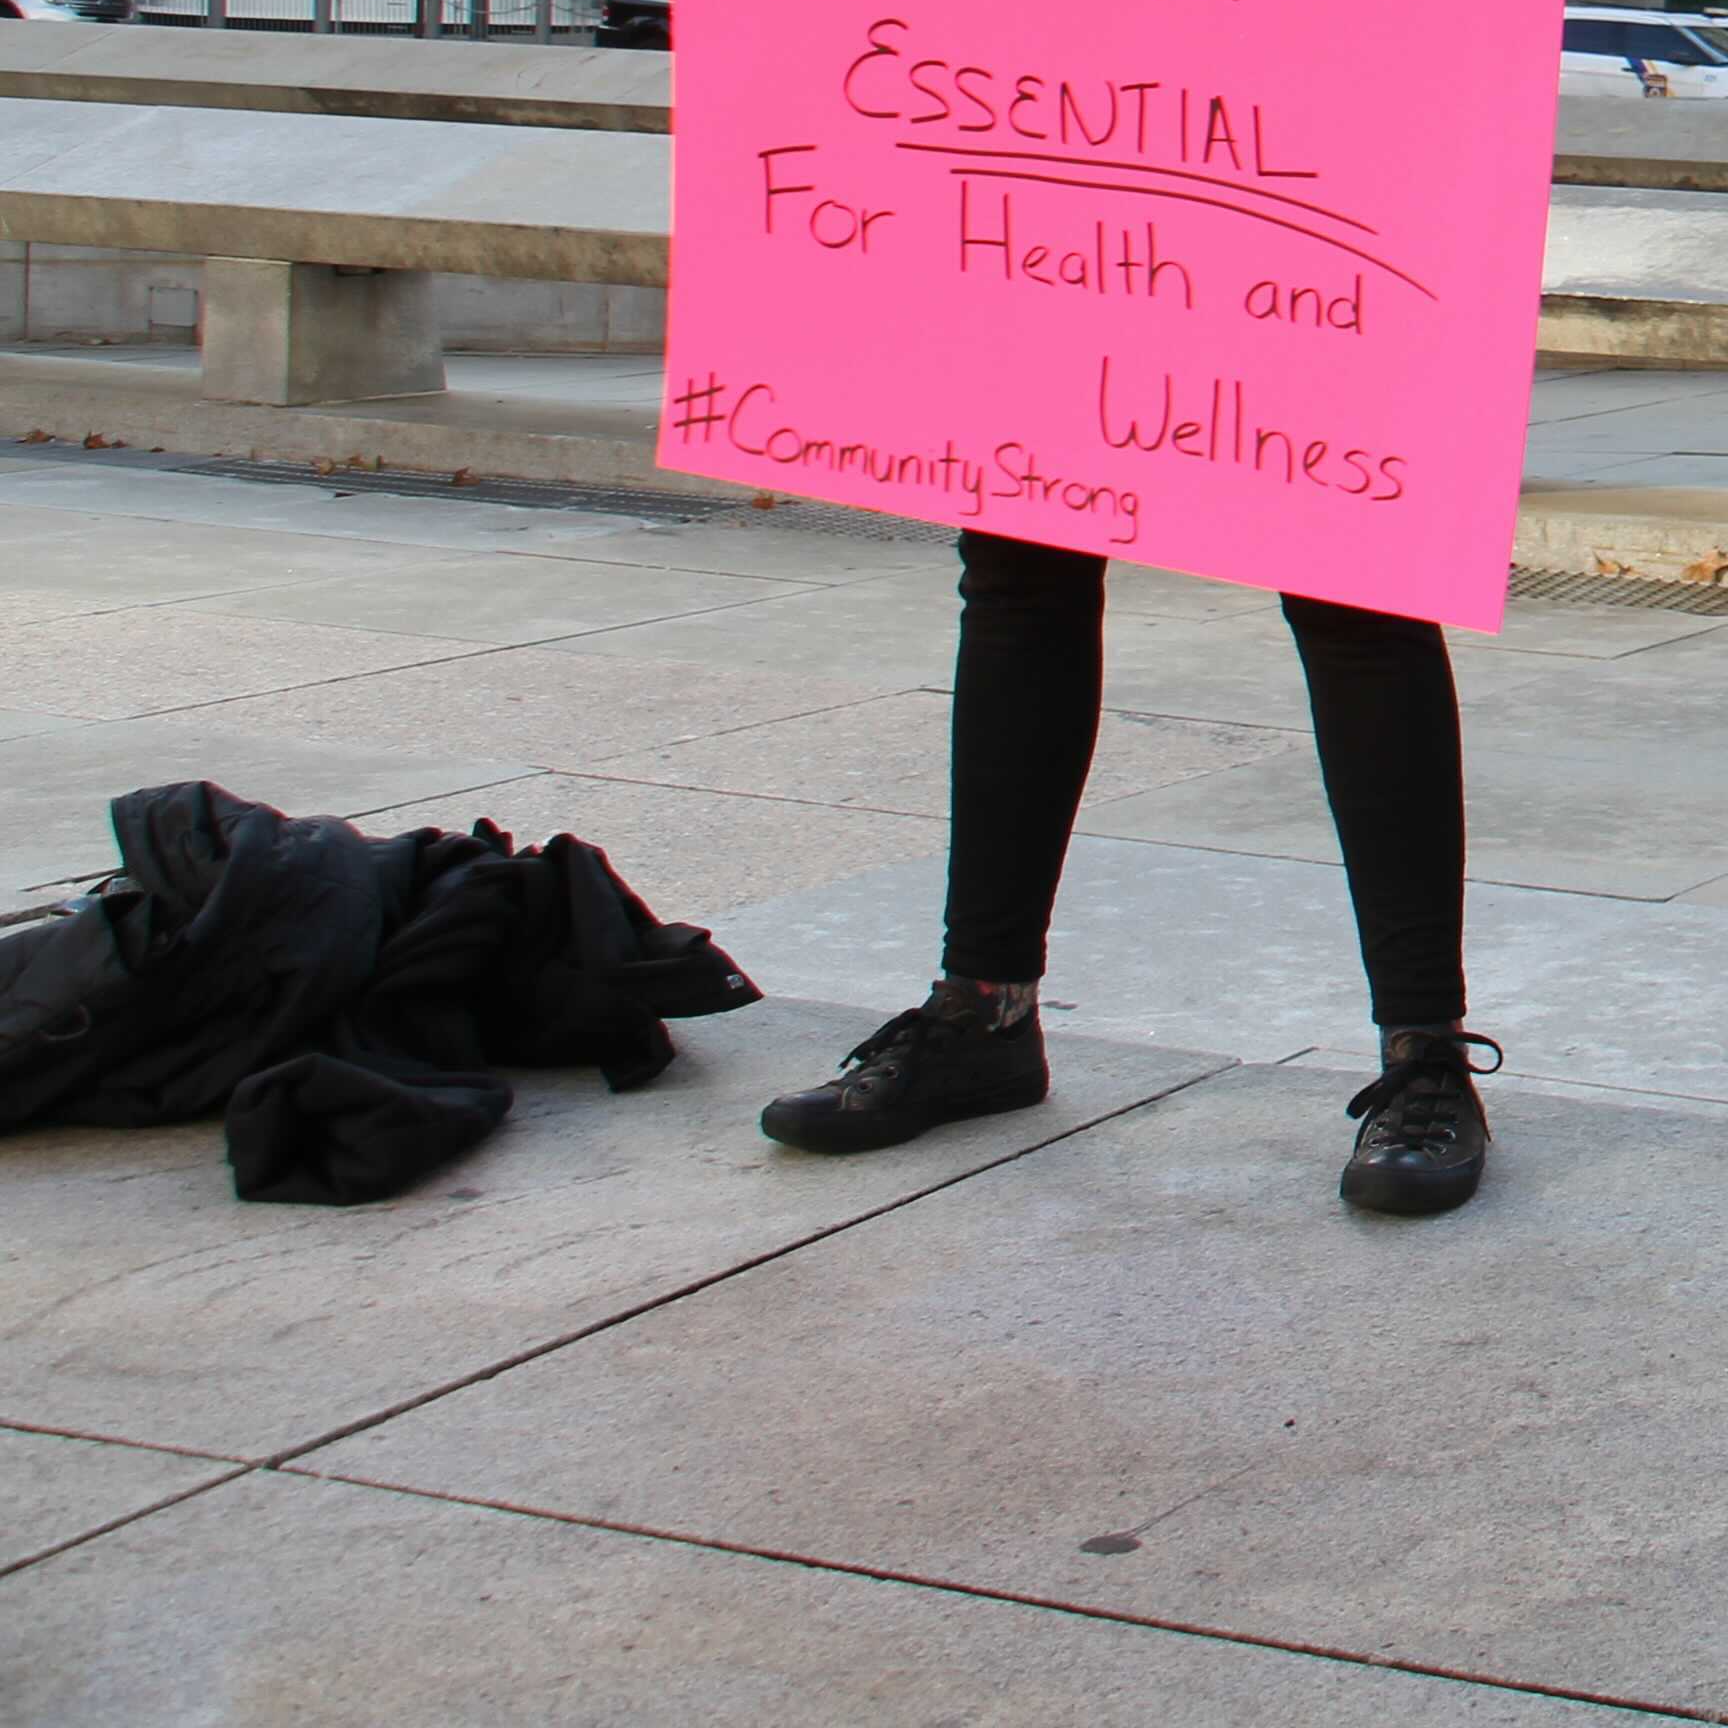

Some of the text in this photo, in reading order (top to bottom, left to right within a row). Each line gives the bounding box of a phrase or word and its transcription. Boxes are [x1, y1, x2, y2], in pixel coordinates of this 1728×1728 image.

[844, 18, 1318, 179] ESSENTIAL
[758, 145, 1362, 335] For Health and
[1100, 356, 1407, 503] Wellness
